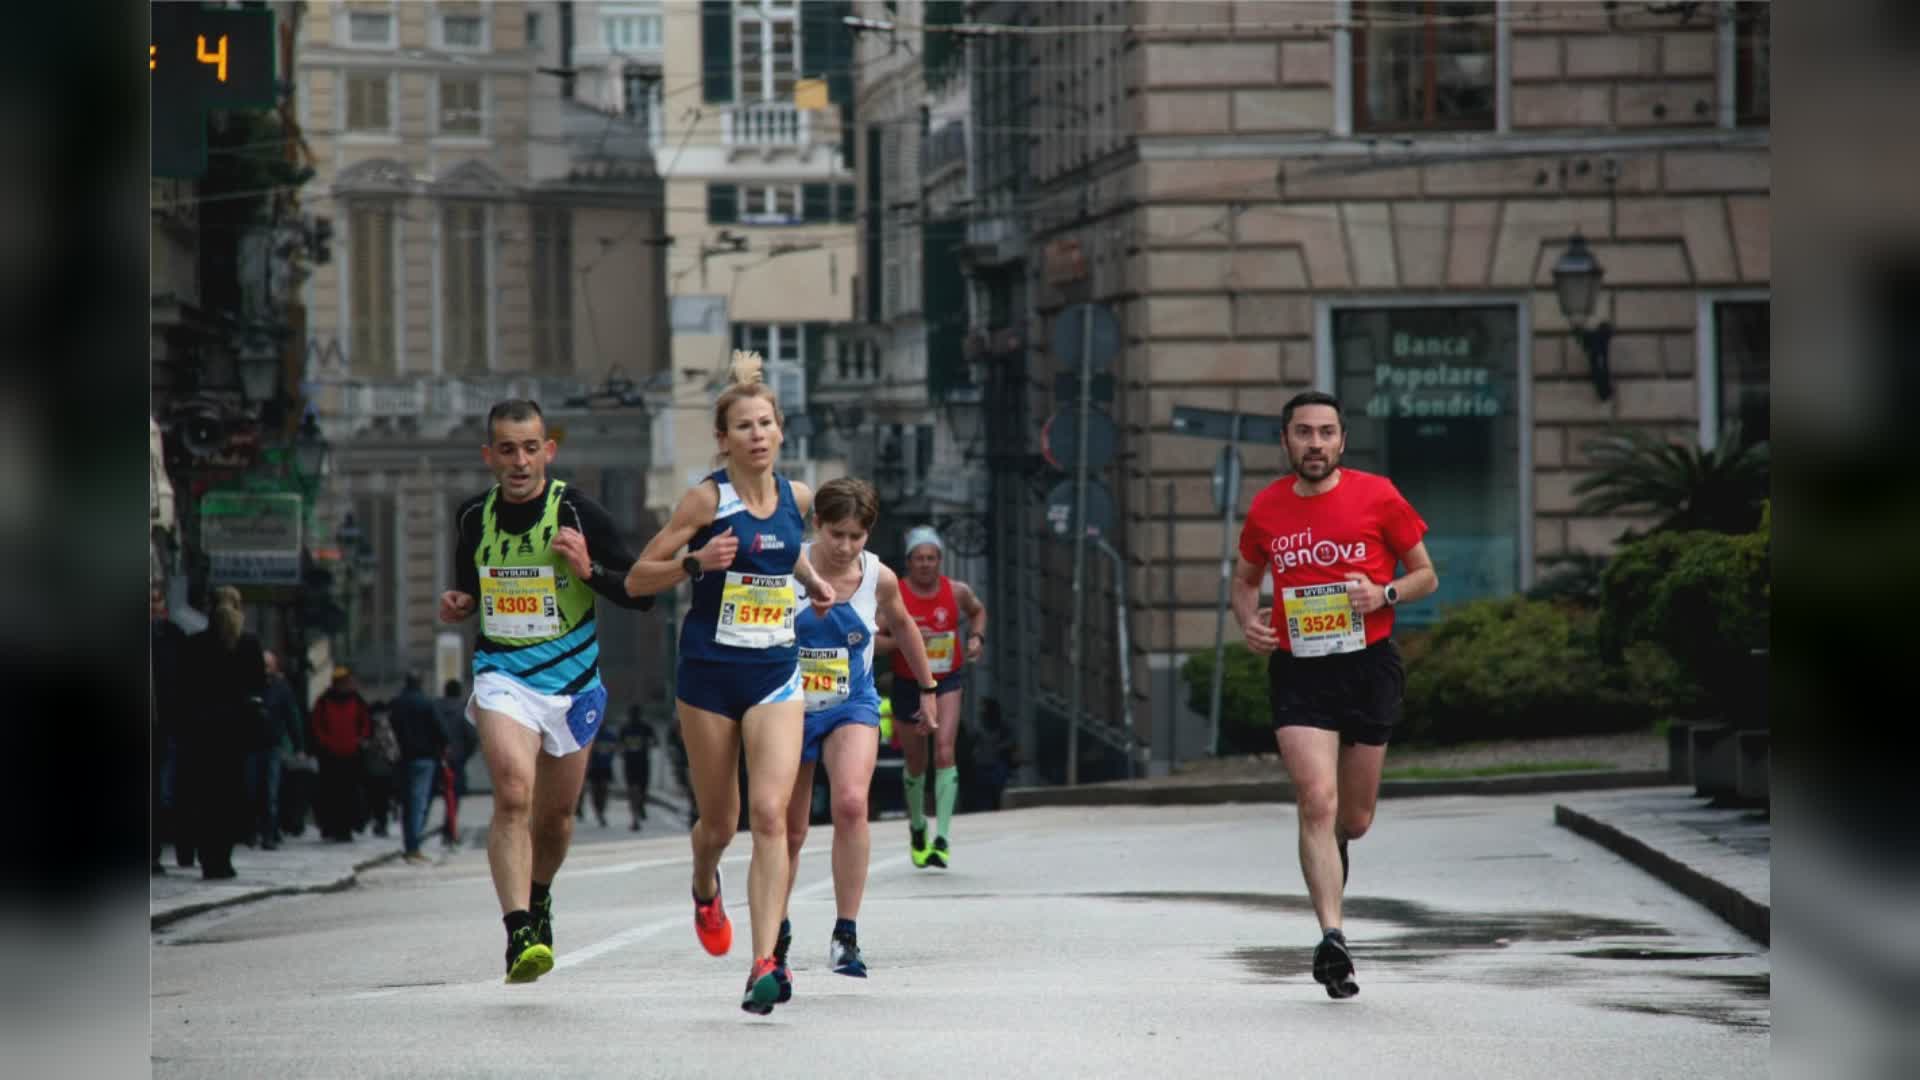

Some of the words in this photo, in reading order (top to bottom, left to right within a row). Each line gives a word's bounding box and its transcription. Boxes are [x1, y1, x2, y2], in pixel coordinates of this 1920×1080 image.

[1393, 332, 1470, 357] Banca
[1376, 363, 1487, 392] Popolare
[1367, 393, 1390, 418] di
[1399, 392, 1498, 419] Sondrio
[1271, 527, 1312, 553] corri
[496, 595, 539, 614] 4303
[739, 604, 782, 624] 5174
[1302, 612, 1347, 634] 3524
